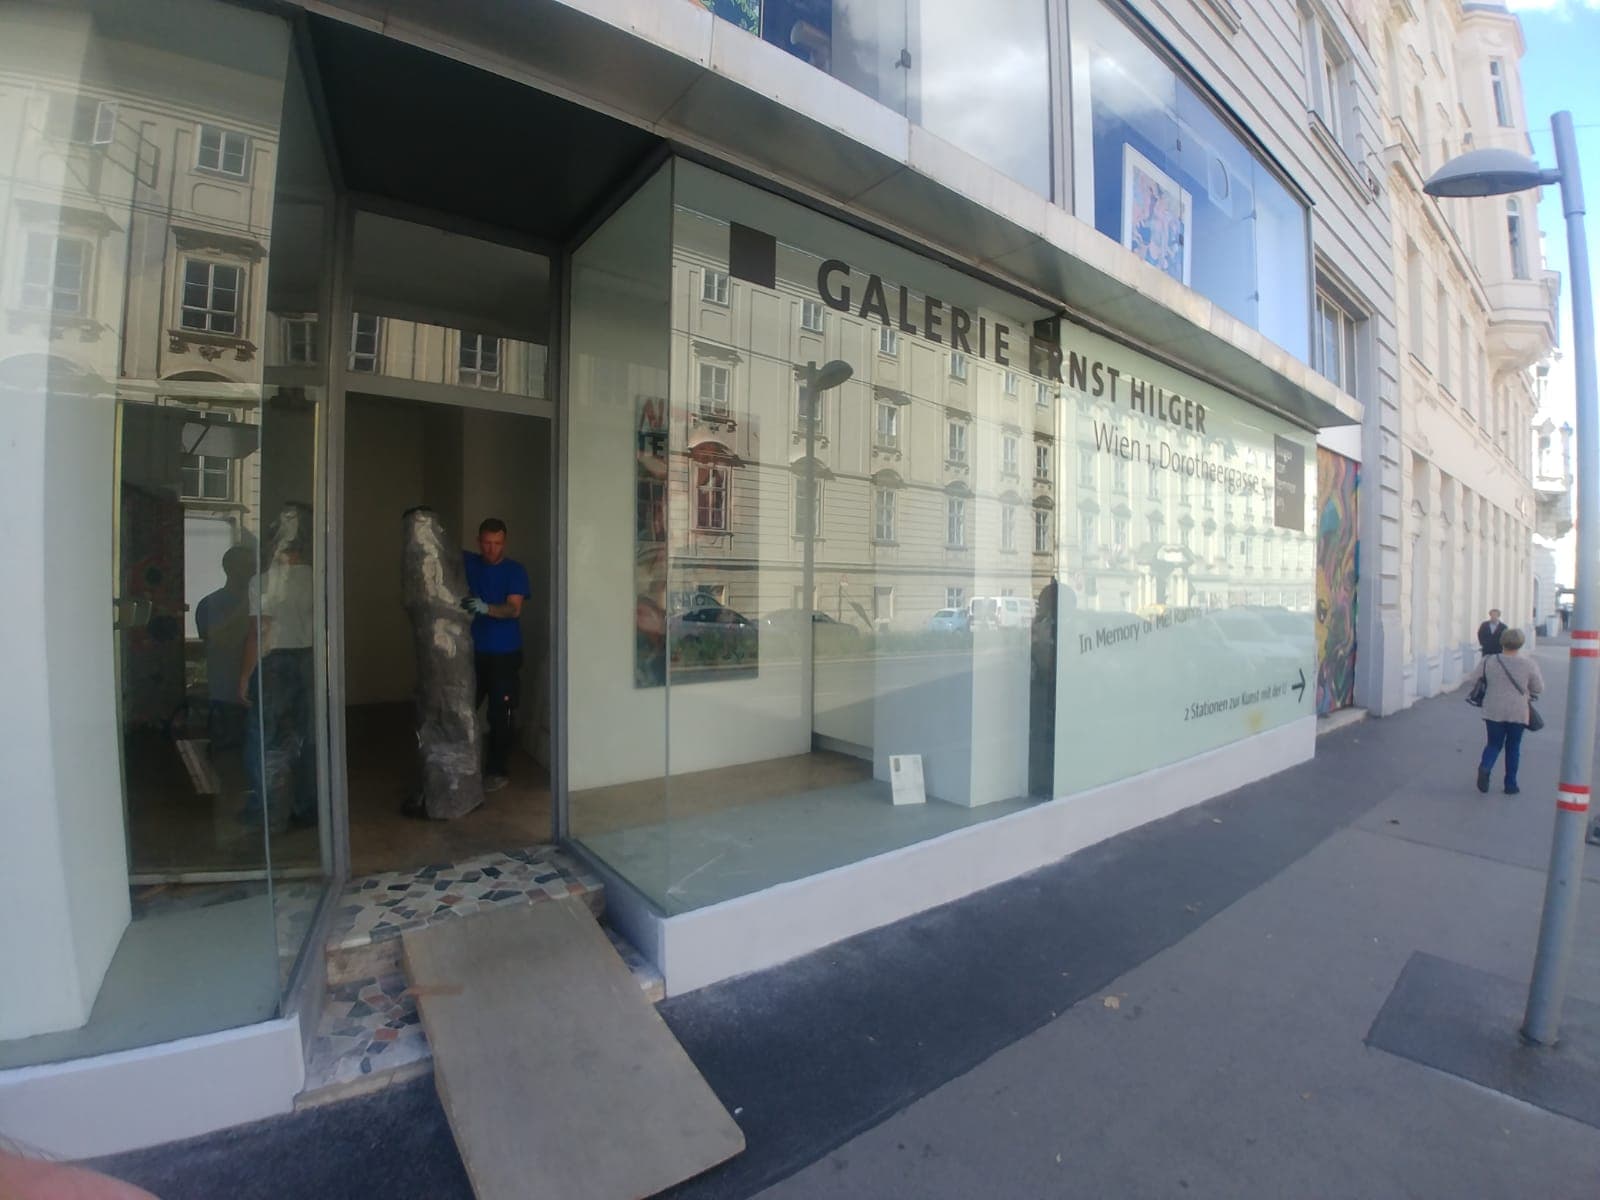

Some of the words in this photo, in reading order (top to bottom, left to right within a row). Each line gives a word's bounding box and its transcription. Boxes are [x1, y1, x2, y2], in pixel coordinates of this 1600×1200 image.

[817, 259, 1010, 367] GALERIE
[1029, 336, 1120, 402] ERNST
[1130, 377, 1206, 435] HILGER
[1094, 420, 1140, 462] Wien
[1159, 441, 1260, 495] Dorotheergasse
[1079, 633, 1093, 655] In
[1095, 622, 1140, 649] Memory
[1184, 707, 1190, 721] 2
[1191, 699, 1228, 719] Stationen
